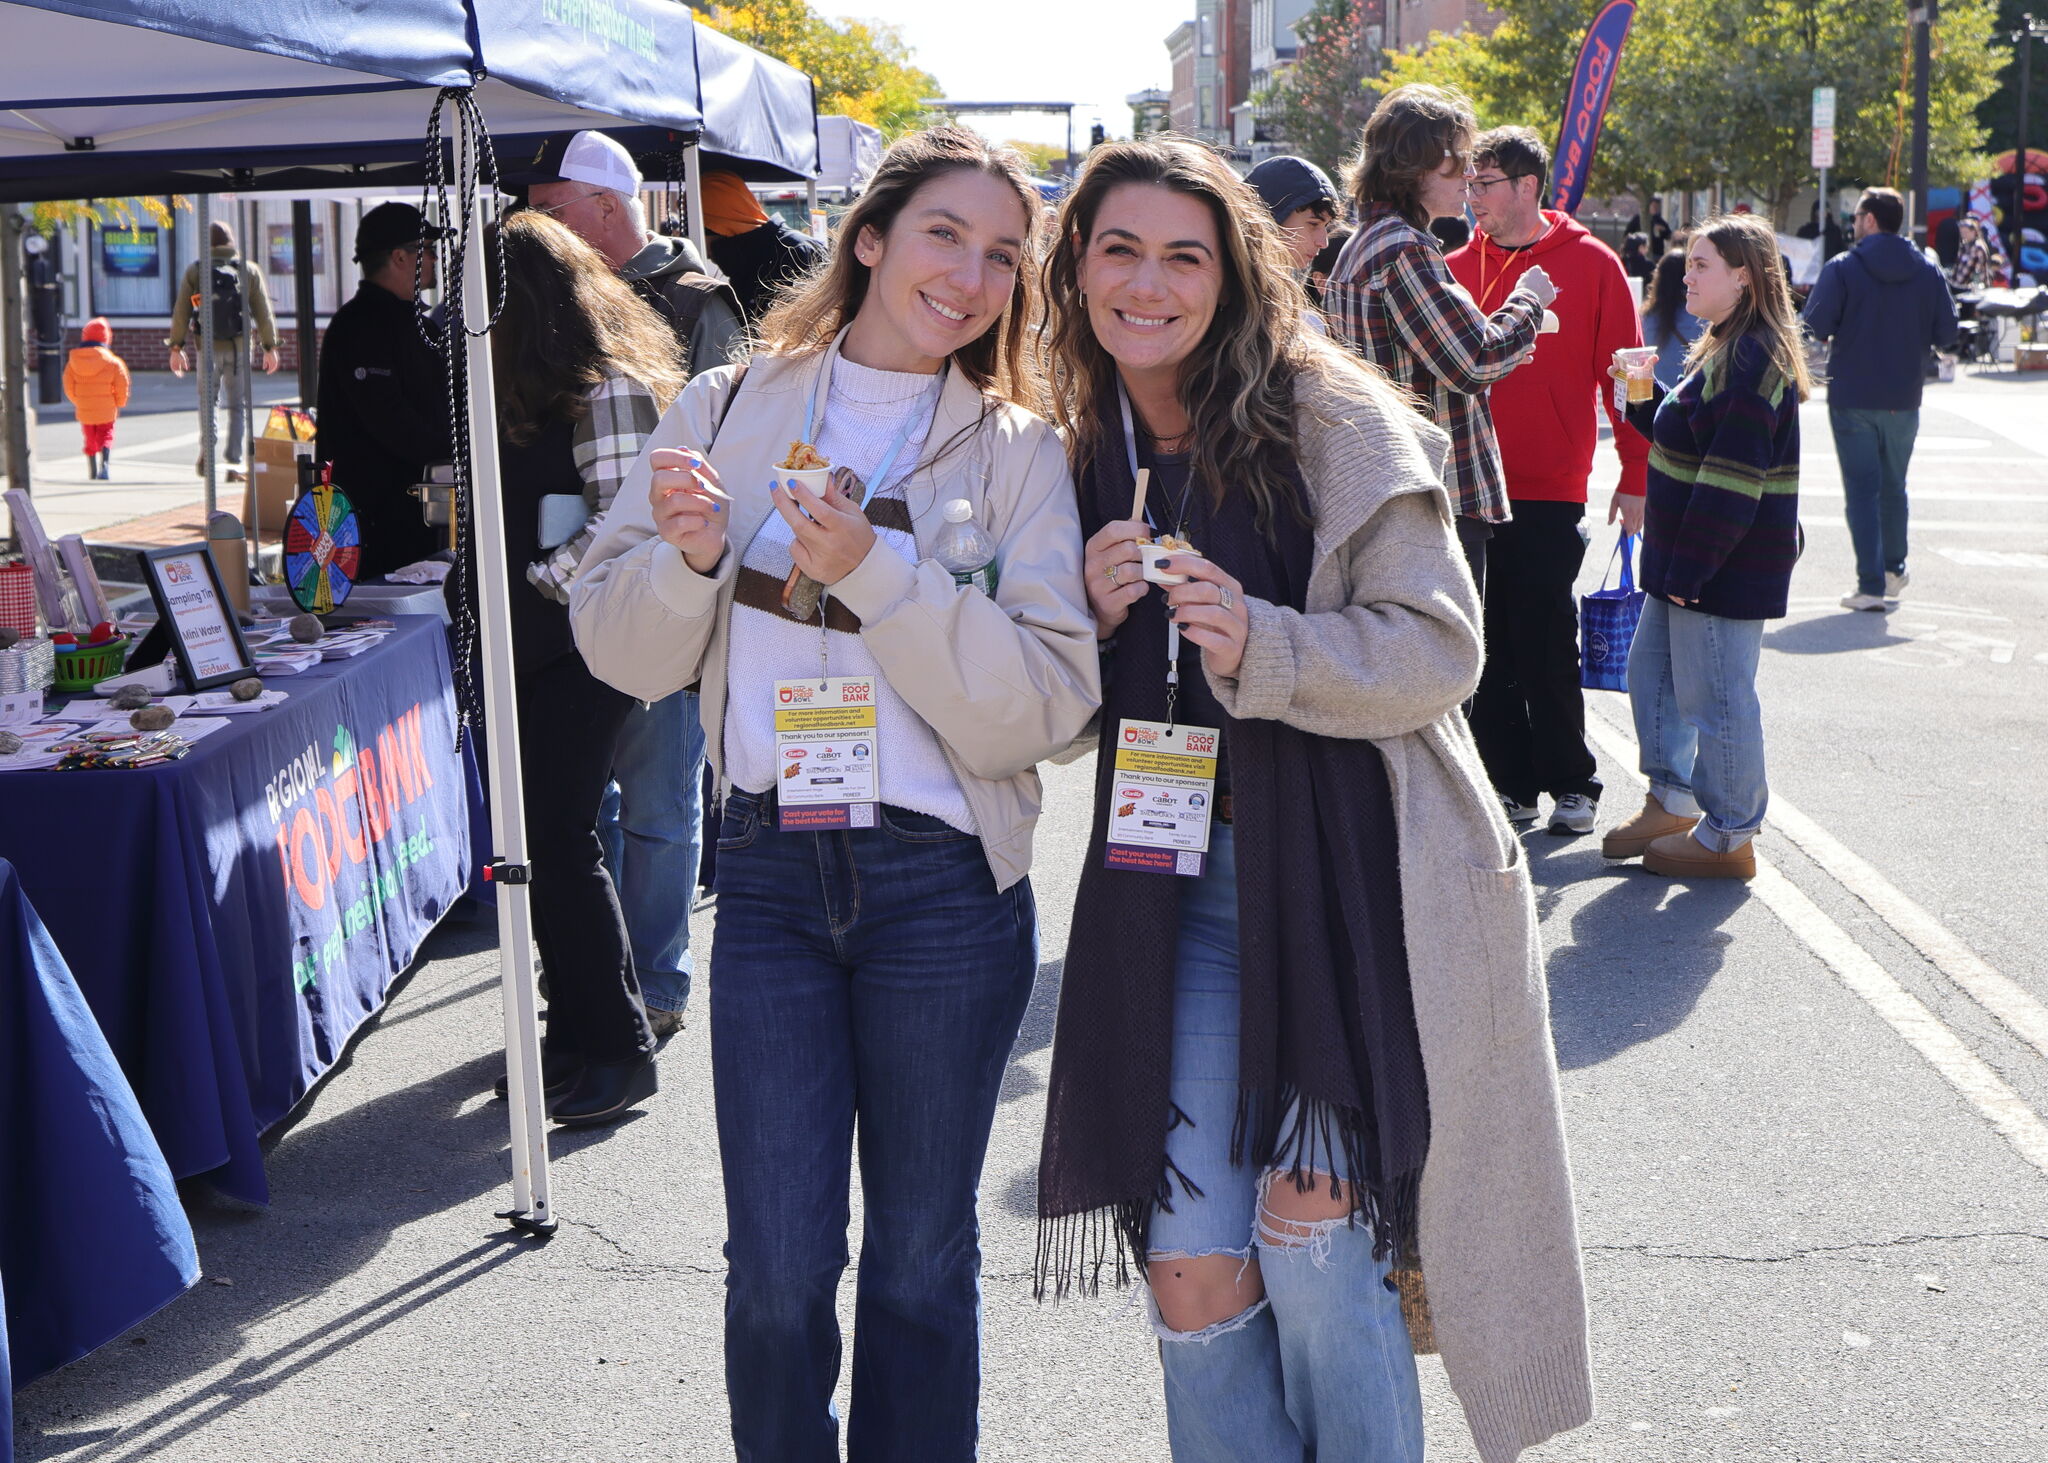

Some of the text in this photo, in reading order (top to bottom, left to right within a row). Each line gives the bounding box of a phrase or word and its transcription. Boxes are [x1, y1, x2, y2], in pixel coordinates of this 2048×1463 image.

[1577, 36, 1609, 142] FOOD
[104, 232, 157, 245] BIGGST
[202, 587, 214, 600] Tin
[182, 623, 222, 640] Mini Water
[842, 685, 870, 694] FOOD
[842, 694, 870, 702] BANK
[802, 733, 815, 741] you
[837, 730, 869, 738] sponsors!
[1187, 736, 1214, 744] FOOD
[1186, 743, 1213, 753] BANK
[1156, 754, 1190, 762] information
[359, 702, 434, 843] BANK
[1120, 772, 1141, 780] Thank
[1141, 775, 1155, 783] you
[1175, 778, 1208, 788] sponsors!
[800, 810, 818, 819] your
[794, 817, 811, 825] best
[1111, 848, 1128, 856] Cast
[1128, 850, 1145, 859] your
[1108, 855, 1121, 863] the
[1121, 856, 1137, 864] best
[1153, 860, 1173, 868] here!
